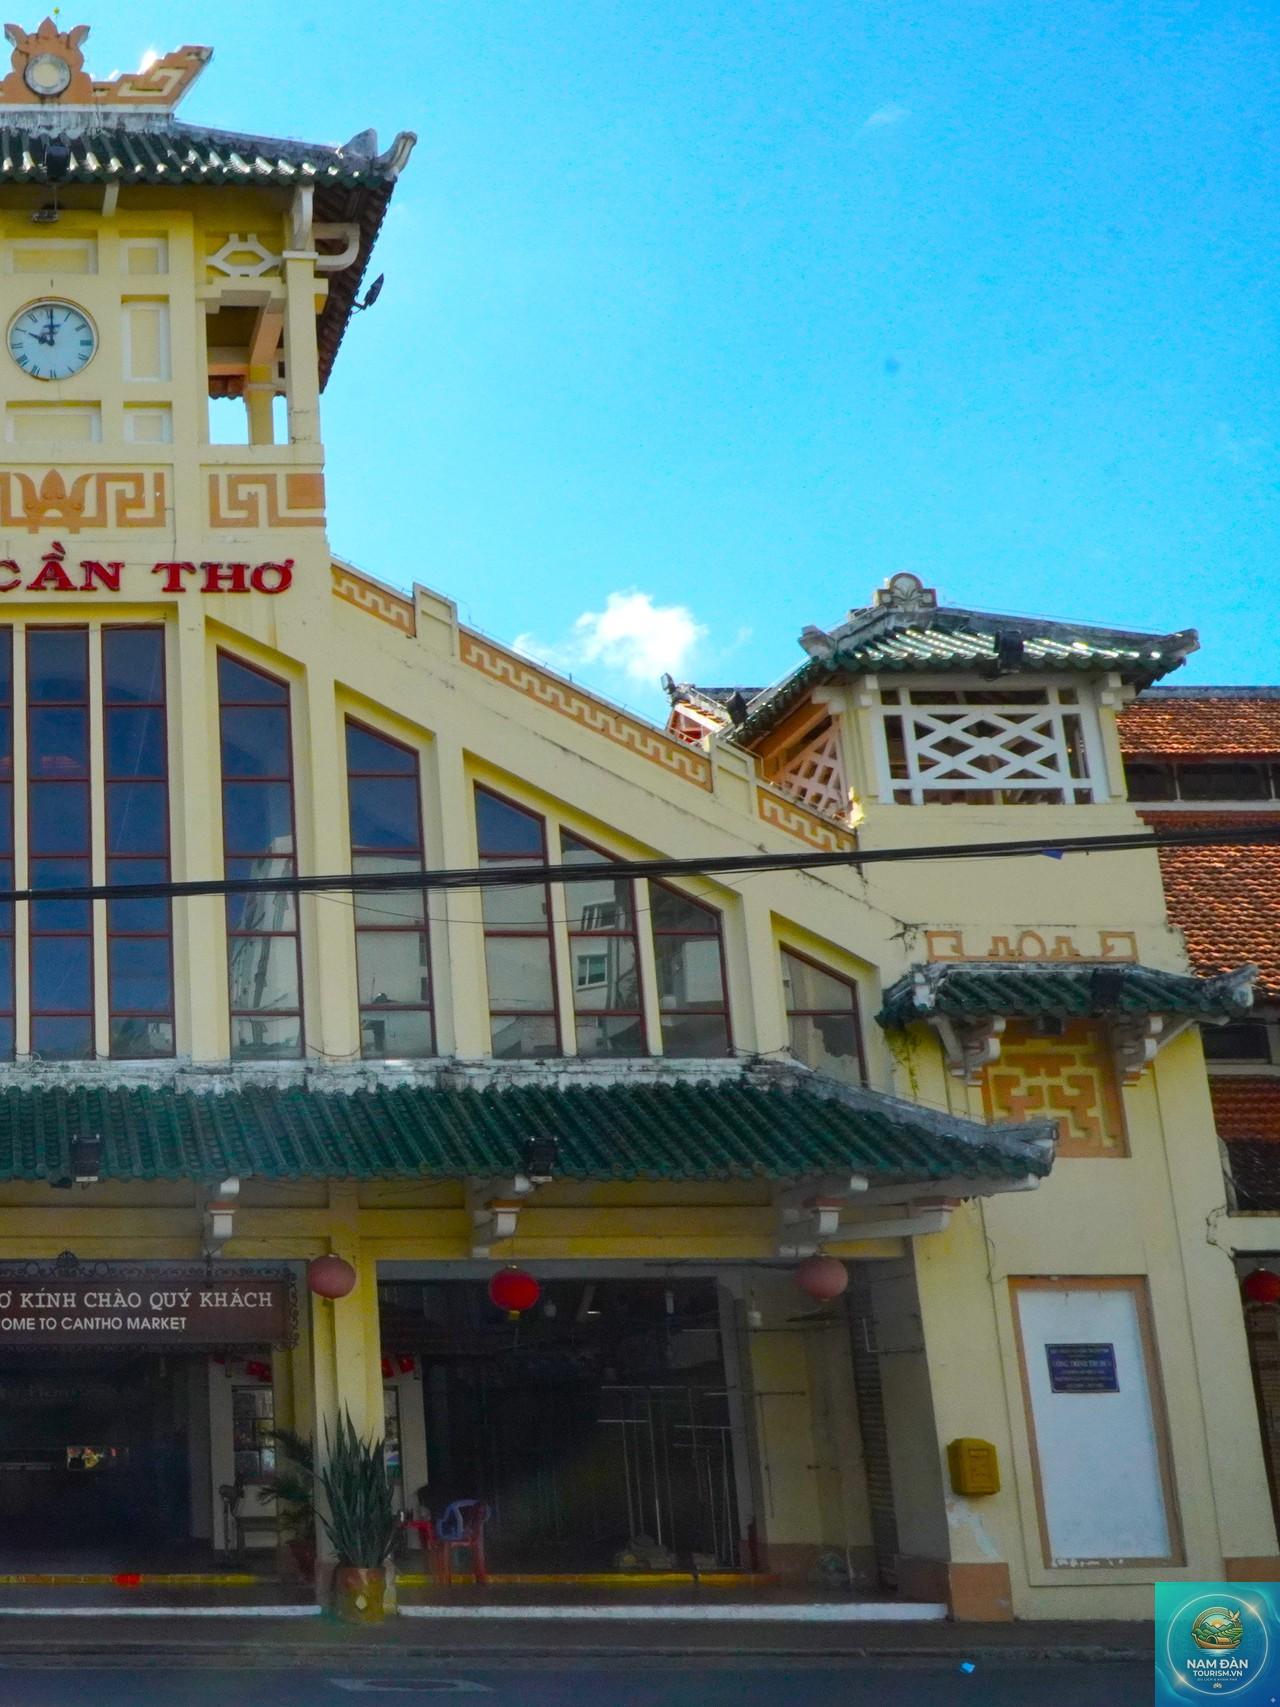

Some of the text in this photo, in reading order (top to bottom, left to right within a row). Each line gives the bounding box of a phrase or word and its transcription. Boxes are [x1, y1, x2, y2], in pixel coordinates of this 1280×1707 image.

[151, 558, 295, 594] THƠ
[20, 1288, 77, 1308] KÍNH
[84, 1288, 142, 1308] CHÀO
[149, 1288, 192, 1311] QUÝ
[199, 1288, 272, 1308] KHÁCH
[39, 1317, 57, 1330] TO
[61, 1317, 123, 1330] CANTHO
[127, 1317, 187, 1330] MARKET
